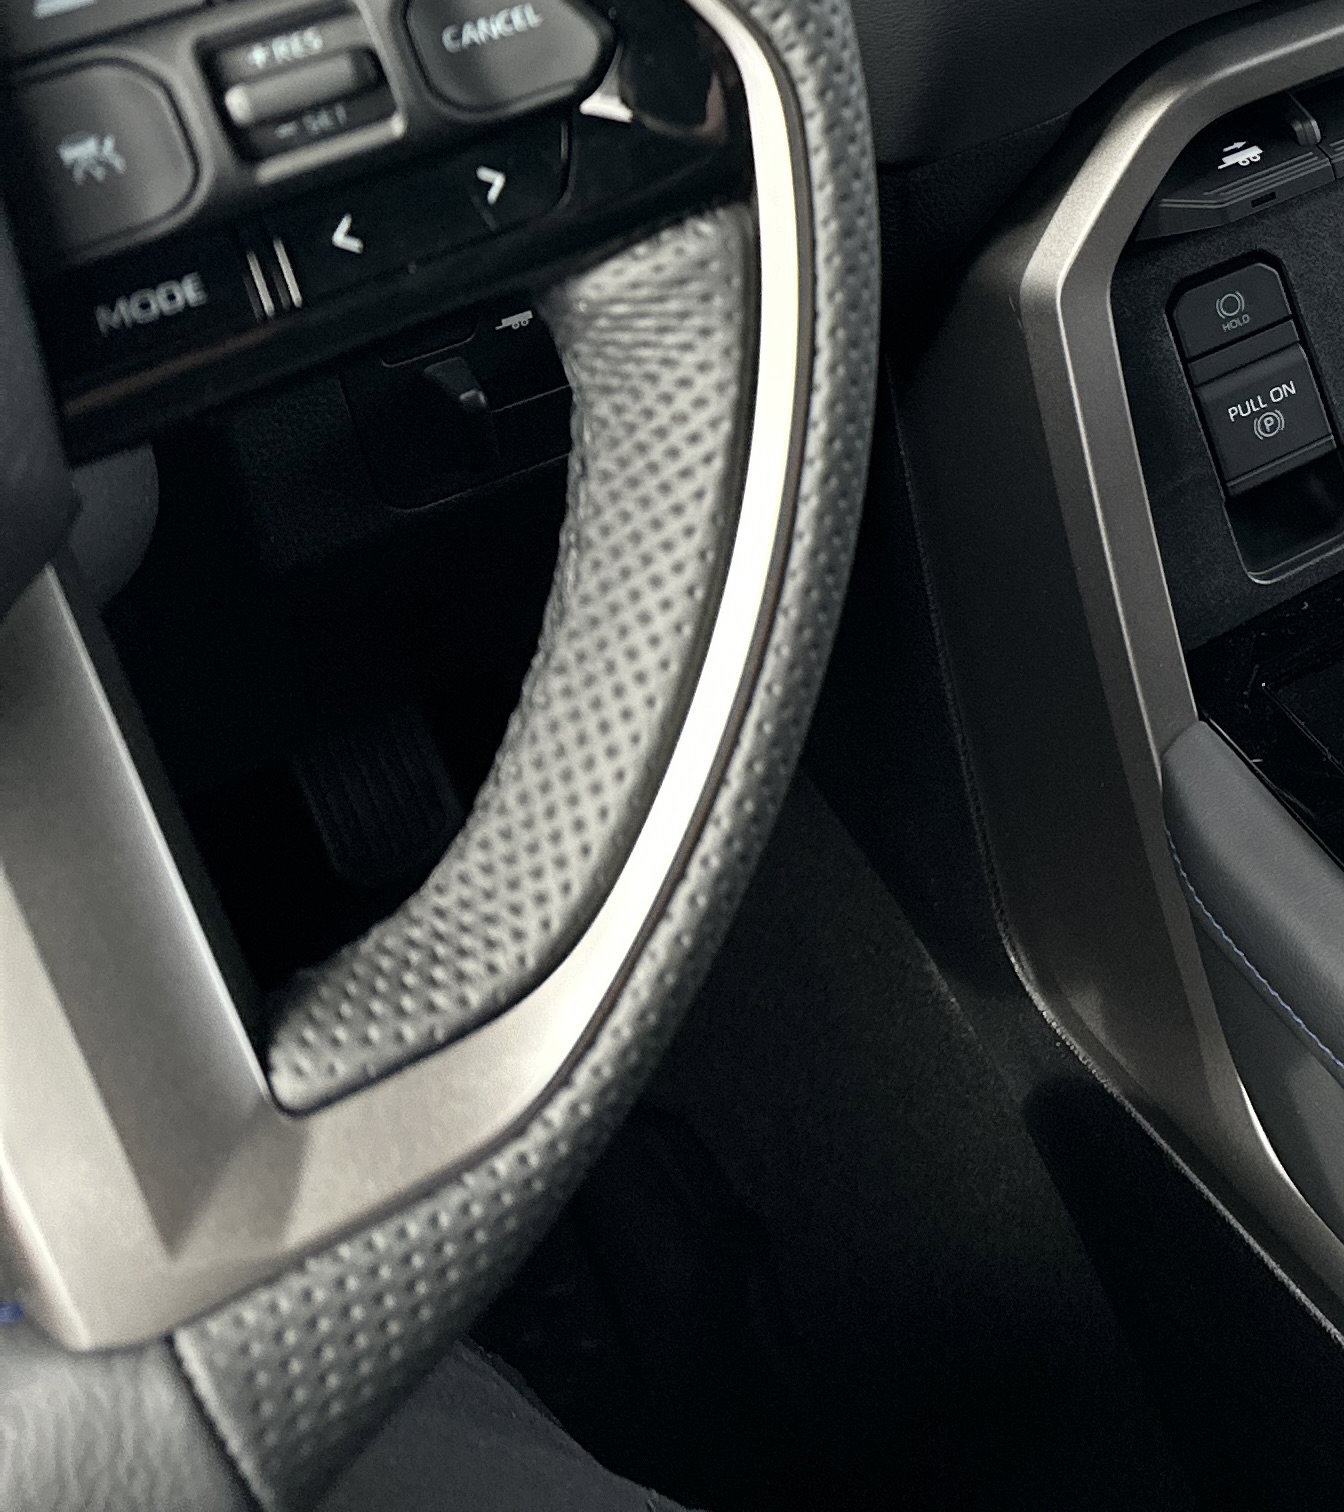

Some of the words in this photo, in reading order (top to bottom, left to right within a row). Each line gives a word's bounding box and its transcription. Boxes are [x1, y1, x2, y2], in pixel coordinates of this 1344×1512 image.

[441, 1, 544, 54] CANCEL
[95, 271, 209, 335] MODE
[1222, 314, 1251, 333] HOLD
[1227, 395, 1268, 422] PULL
[1269, 380, 1297, 403] ON
